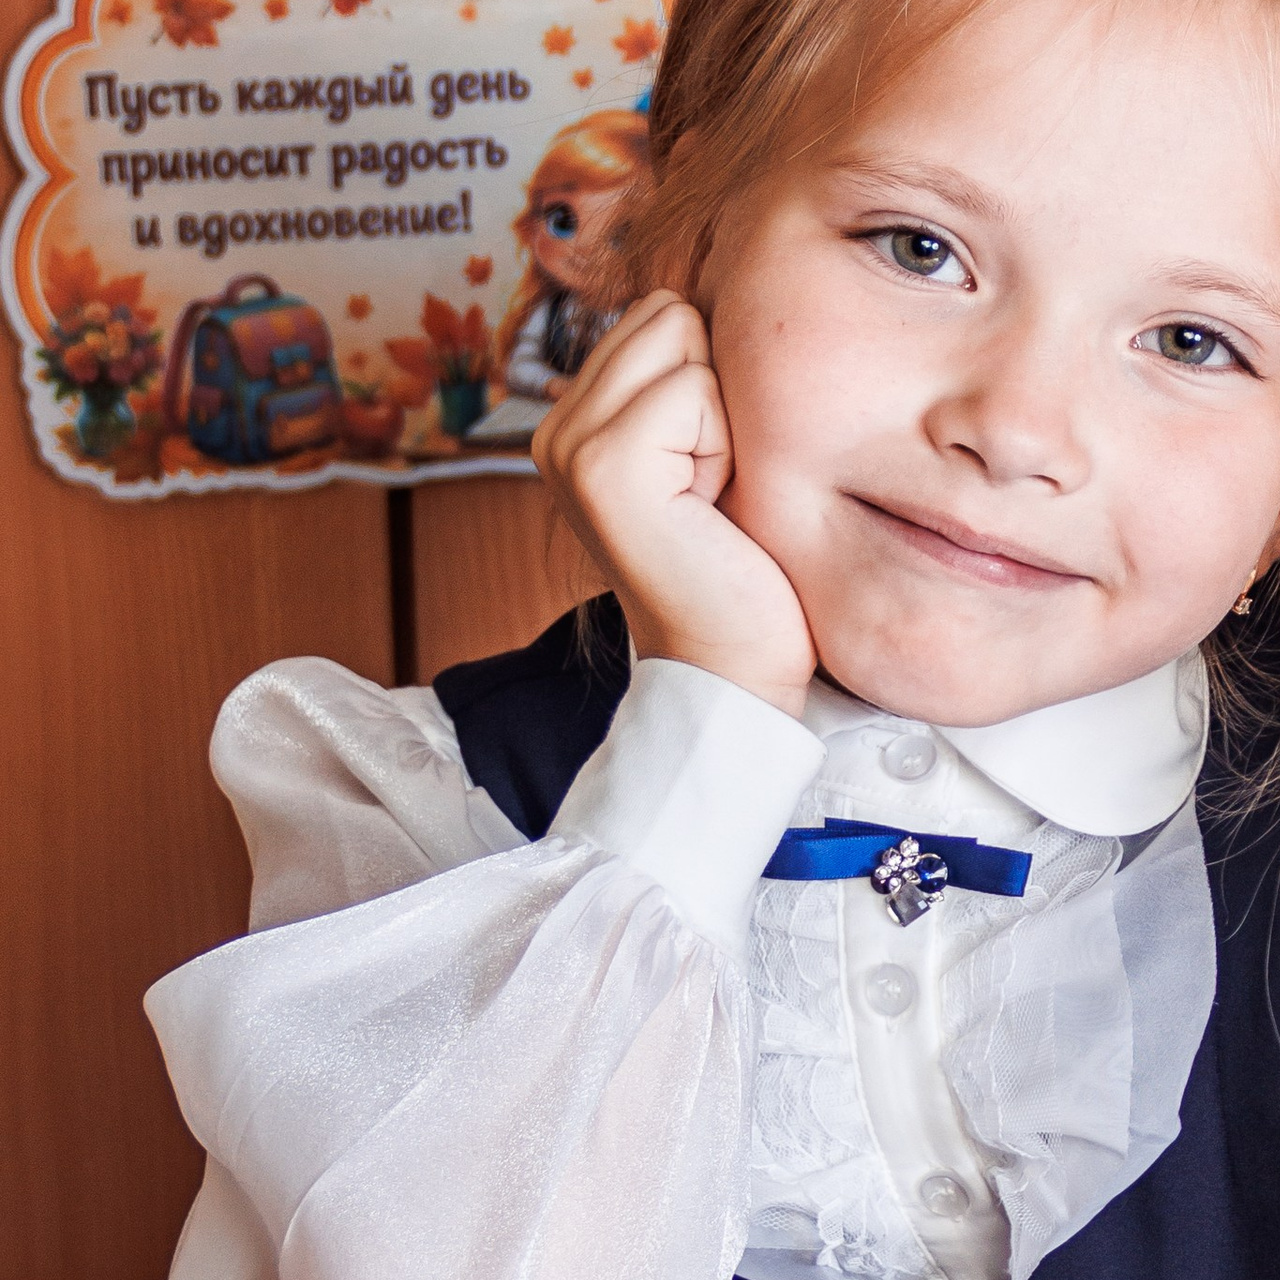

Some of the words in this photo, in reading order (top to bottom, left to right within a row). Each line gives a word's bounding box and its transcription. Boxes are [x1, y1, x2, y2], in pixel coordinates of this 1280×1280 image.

[84, 70, 220, 132] Пусть
[235, 64, 414, 125] каждый
[430, 64, 531, 117] день
[102, 144, 315, 195] приносит
[332, 133, 509, 193] радость
[134, 214, 161, 247] и
[177, 190, 474, 258] вдохновение!
